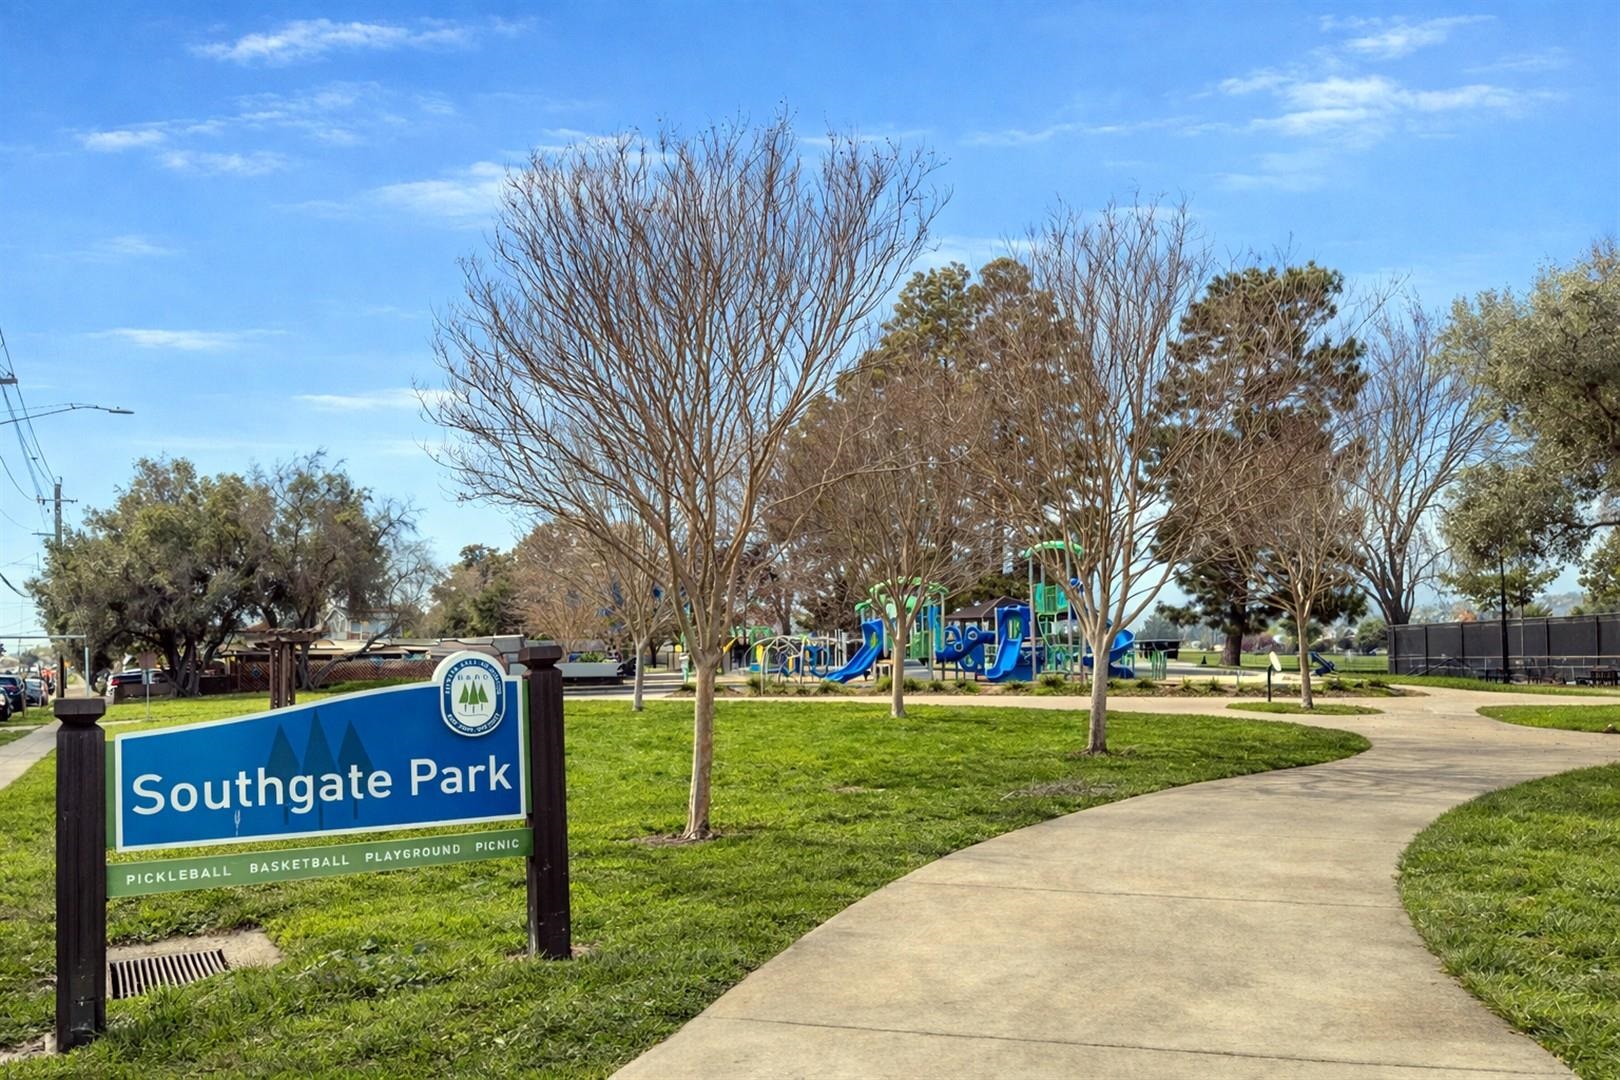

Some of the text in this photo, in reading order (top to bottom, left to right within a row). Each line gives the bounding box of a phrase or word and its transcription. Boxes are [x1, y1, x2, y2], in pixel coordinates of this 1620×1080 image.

[132, 755, 513, 814] Southgate Park
[126, 838, 521, 885] PICKLEBALL BASKETBALL PLAYGROUND PICNIC
